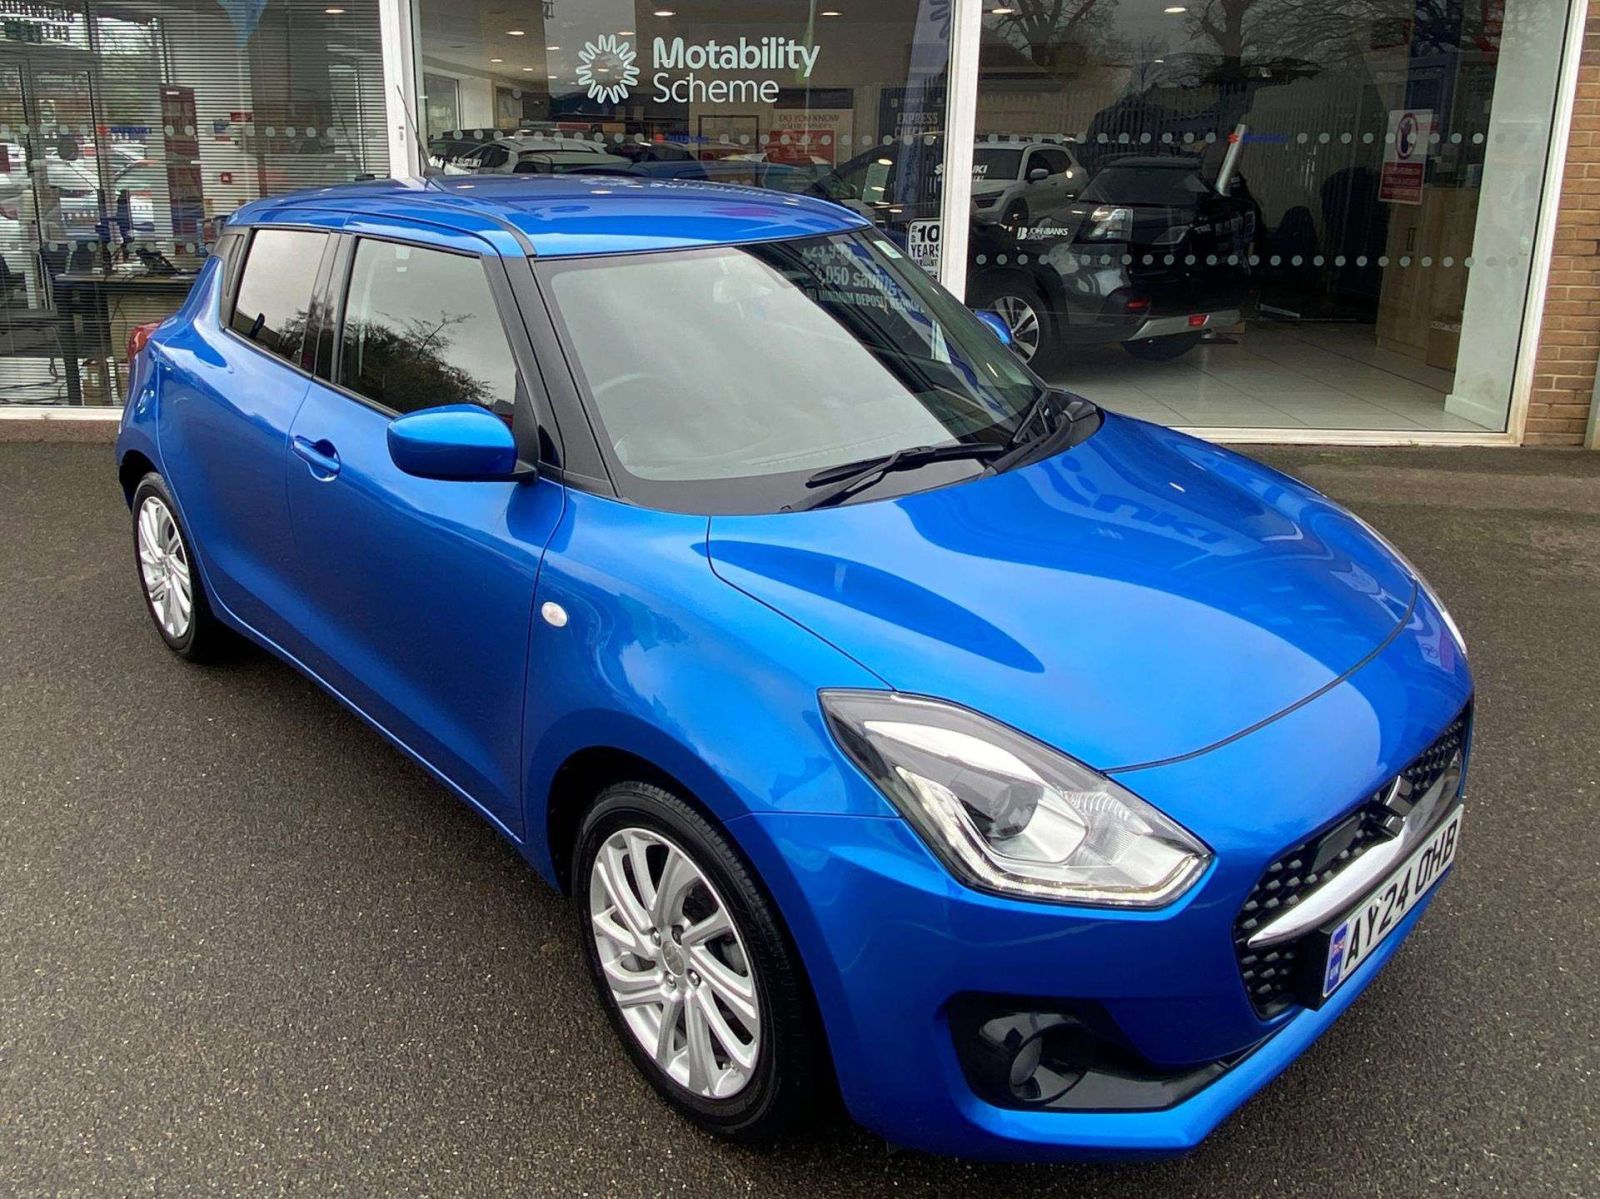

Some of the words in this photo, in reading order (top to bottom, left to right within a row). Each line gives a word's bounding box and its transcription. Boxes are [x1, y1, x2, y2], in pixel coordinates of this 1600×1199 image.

[653, 36, 821, 77] Motability
[652, 72, 780, 103] Scheme
[918, 224, 940, 243] 10
[1344, 866, 1412, 970] AY24
[1414, 819, 1458, 895] OHB
